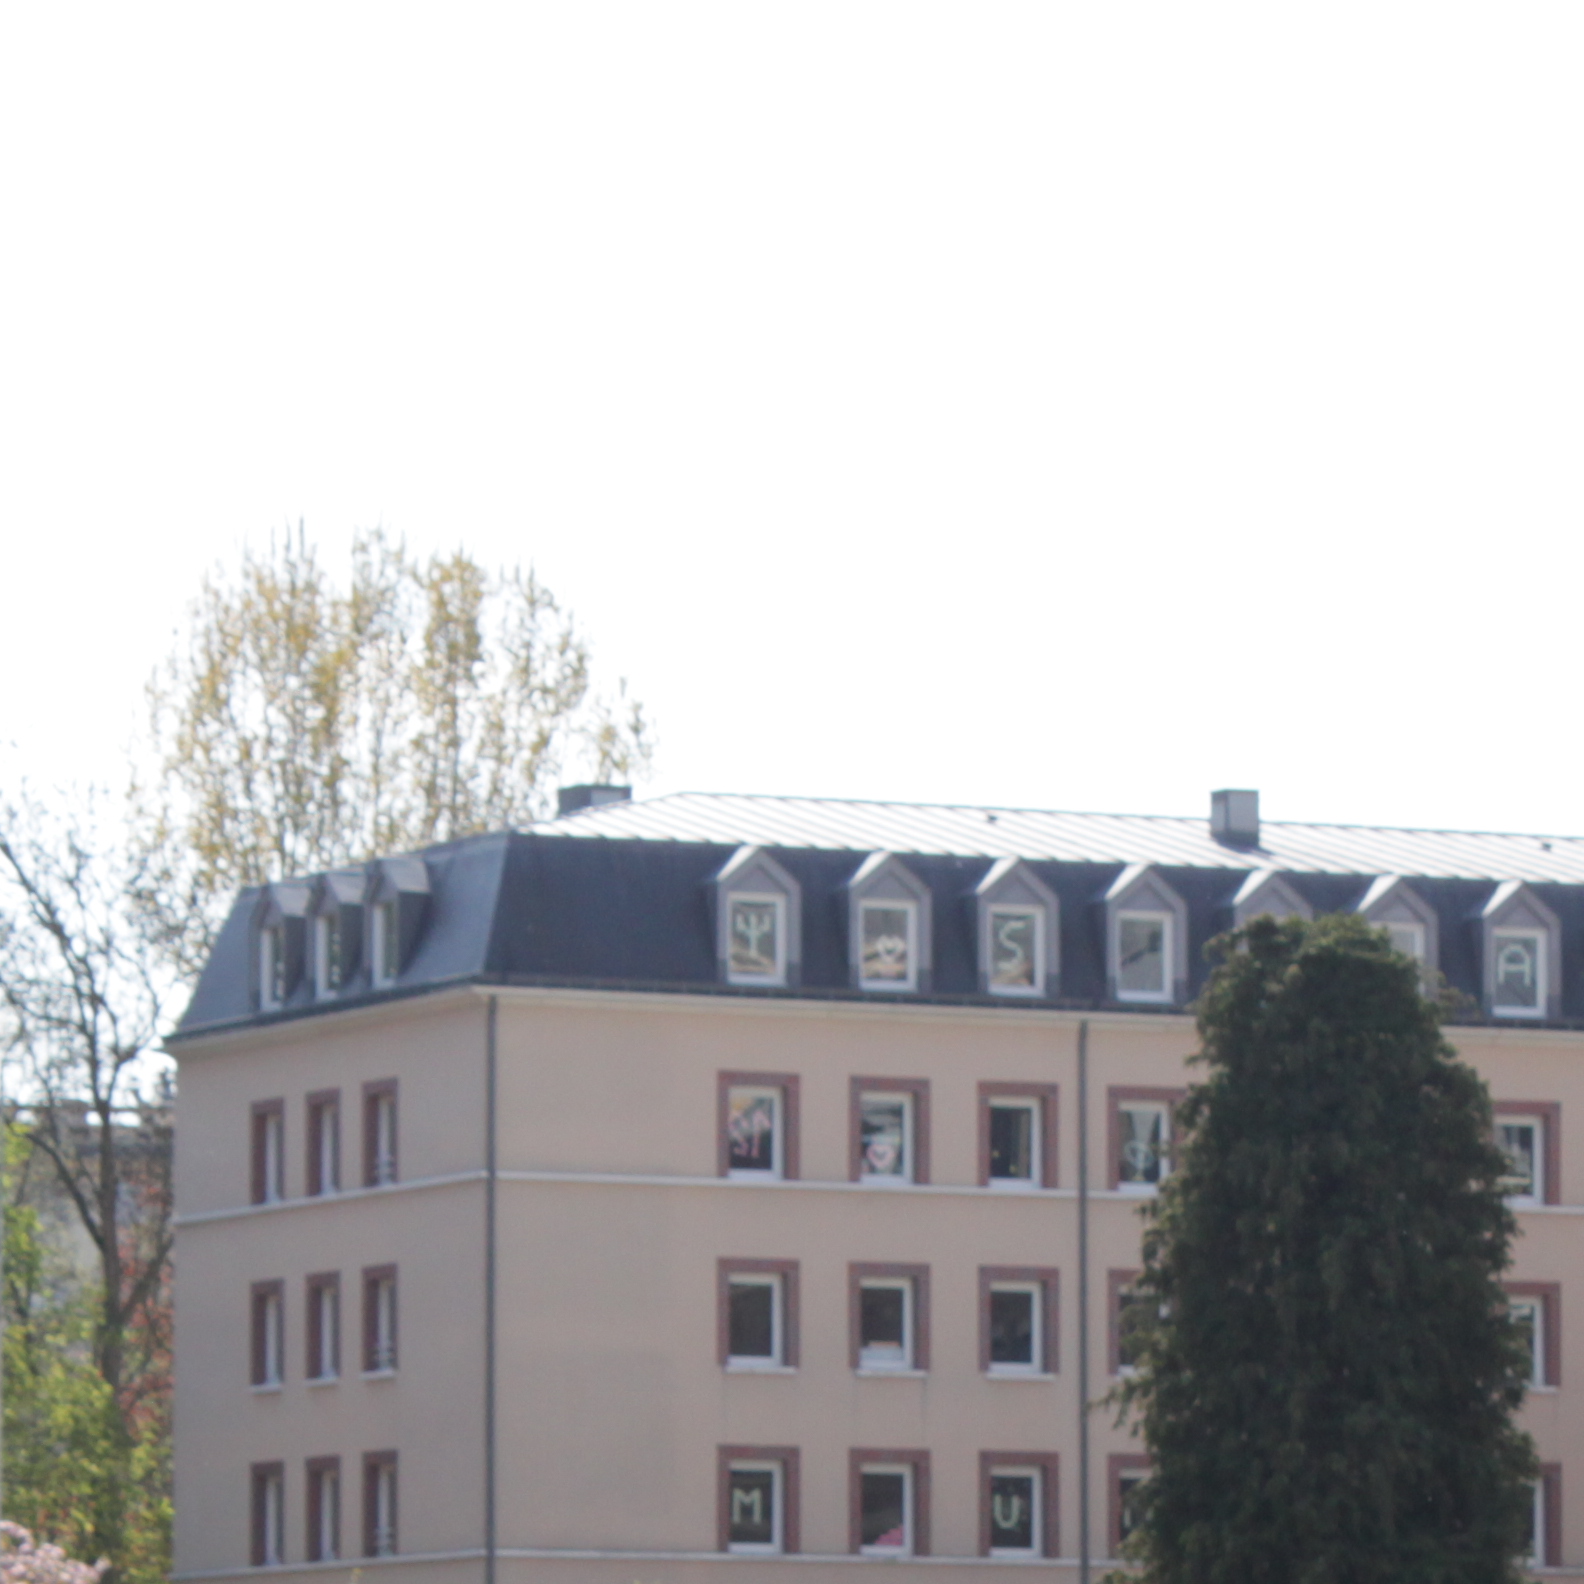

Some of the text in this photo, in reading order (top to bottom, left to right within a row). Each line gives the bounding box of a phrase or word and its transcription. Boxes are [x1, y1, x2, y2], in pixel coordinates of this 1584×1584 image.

[997, 920, 1027, 971] S
[1497, 943, 1531, 986] A
[732, 1487, 763, 1524] M
[993, 1494, 1022, 1530] U
